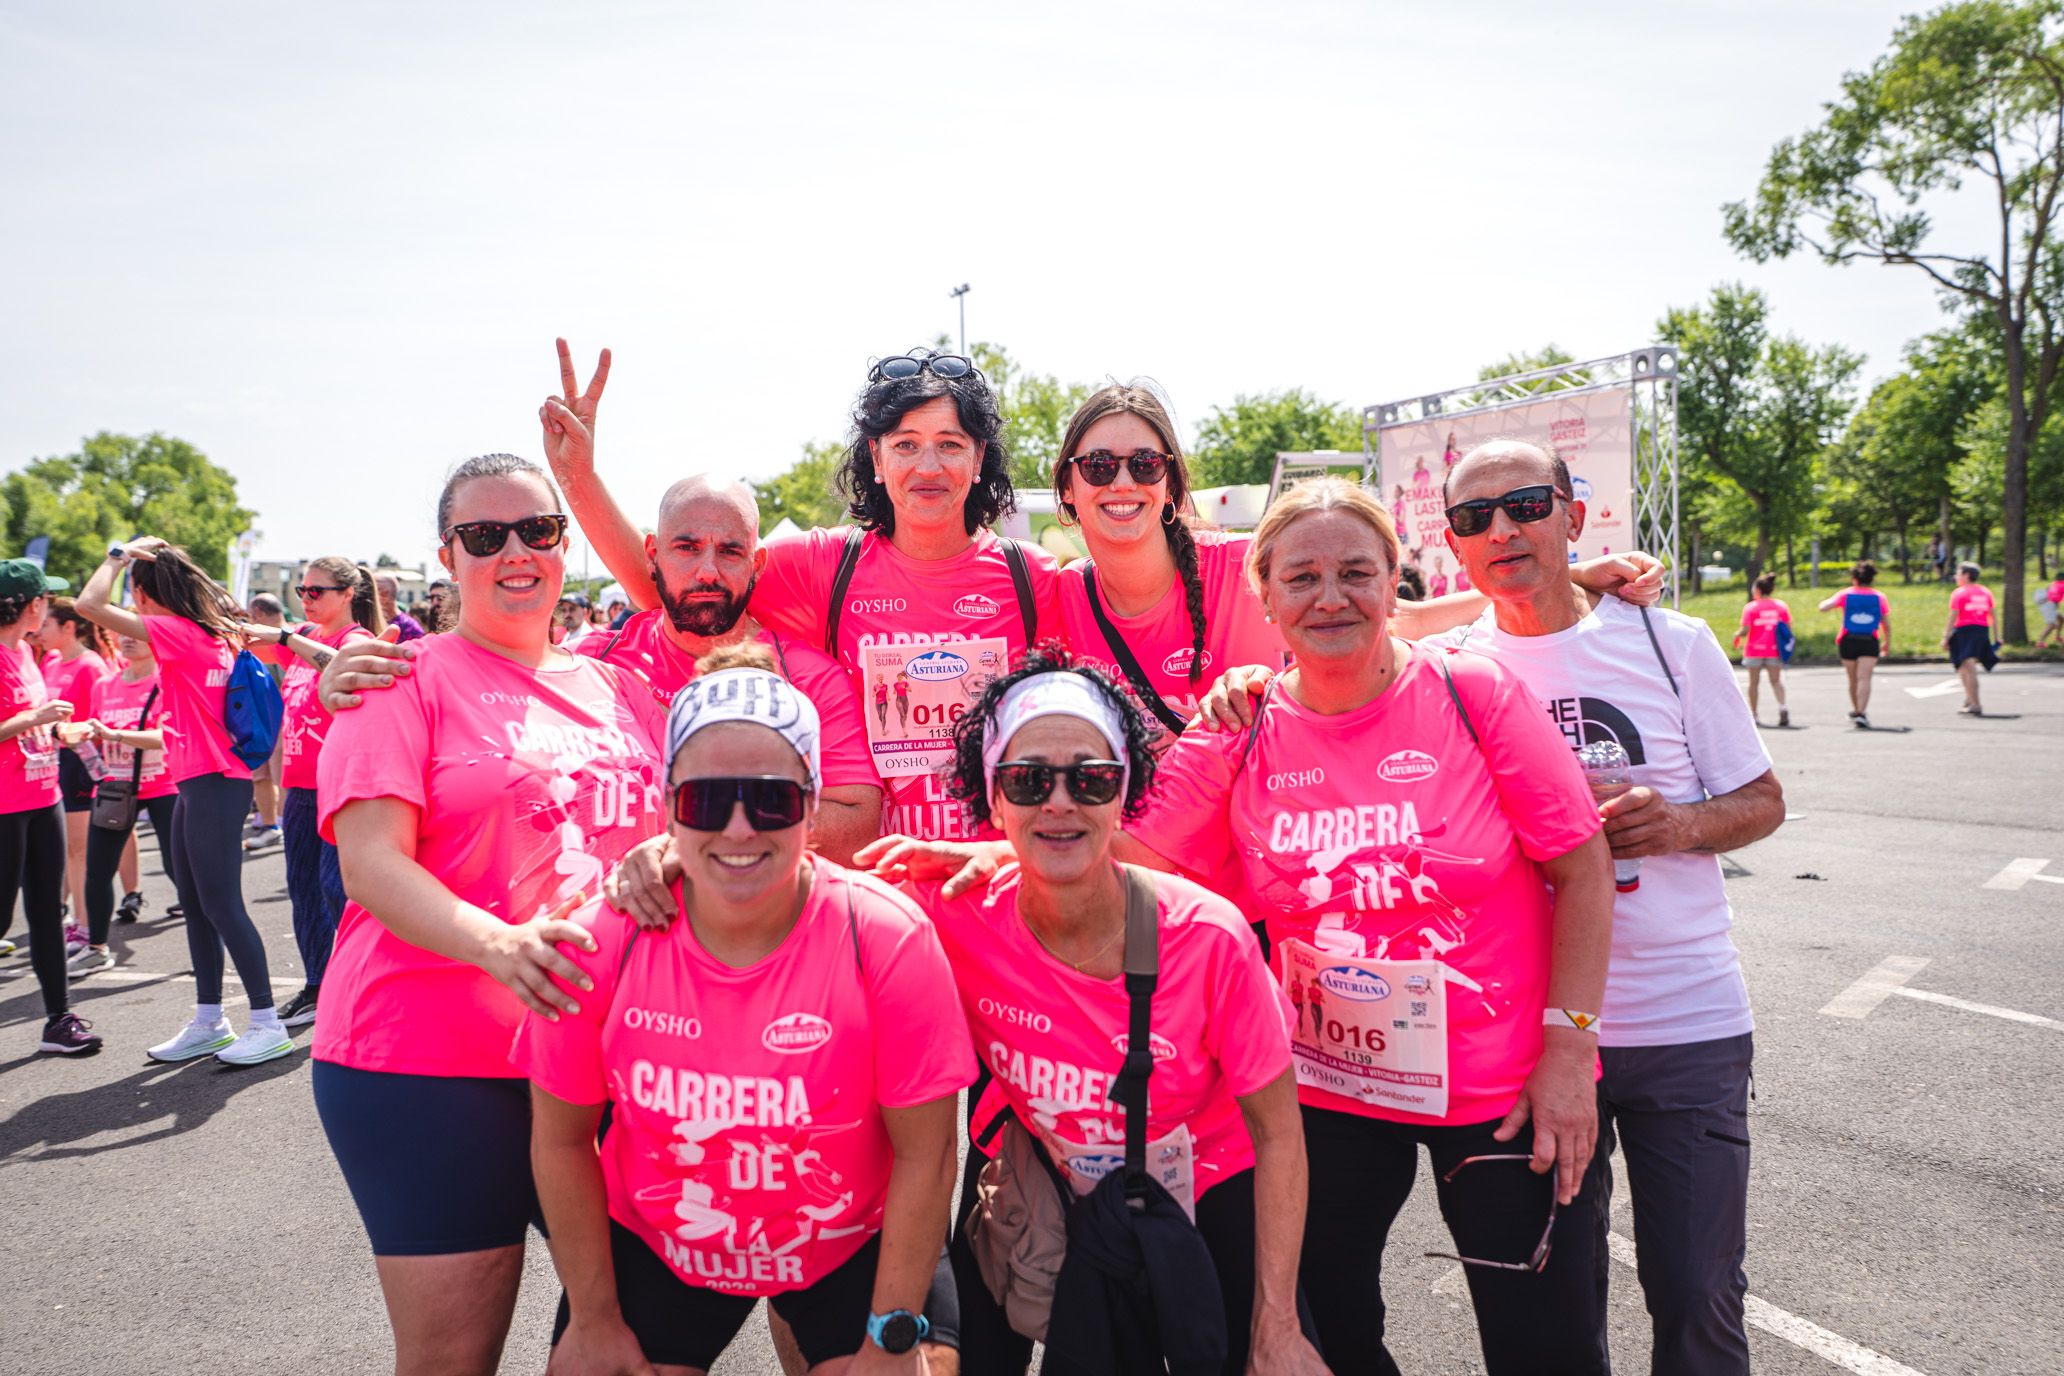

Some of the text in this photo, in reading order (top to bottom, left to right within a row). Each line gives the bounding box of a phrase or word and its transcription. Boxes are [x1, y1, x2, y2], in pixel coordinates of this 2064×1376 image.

[851, 598, 907, 614] OYSHO
[875, 659, 903, 667] SUMA
[910, 663, 965, 675] ASTURIANA
[480, 690, 541, 708] OYSHO
[913, 703, 966, 725] 016
[873, 743, 902, 752] CARRERA
[904, 742, 913, 750] DE
[914, 741, 923, 749] LA
[923, 741, 947, 749] MUJER
[885, 756, 929, 769] OYSHO
[1266, 768, 1325, 791] OYSHO
[593, 771, 640, 828] DE
[1269, 801, 1423, 853] CARRERA
[1324, 973, 1385, 996] ASTURIANA
[624, 1007, 702, 1040] OYSHO
[978, 998, 1052, 1034] OYSHO
[1327, 1019, 1386, 1052] 016
[1344, 1050, 1373, 1065] 1139
[1300, 1063, 1345, 1087] OYSHO
[631, 1060, 813, 1128] CARRERA
[1375, 1087, 1425, 1104] Santander
[729, 1139, 787, 1191] DE
[659, 1231, 804, 1283] MUJER
